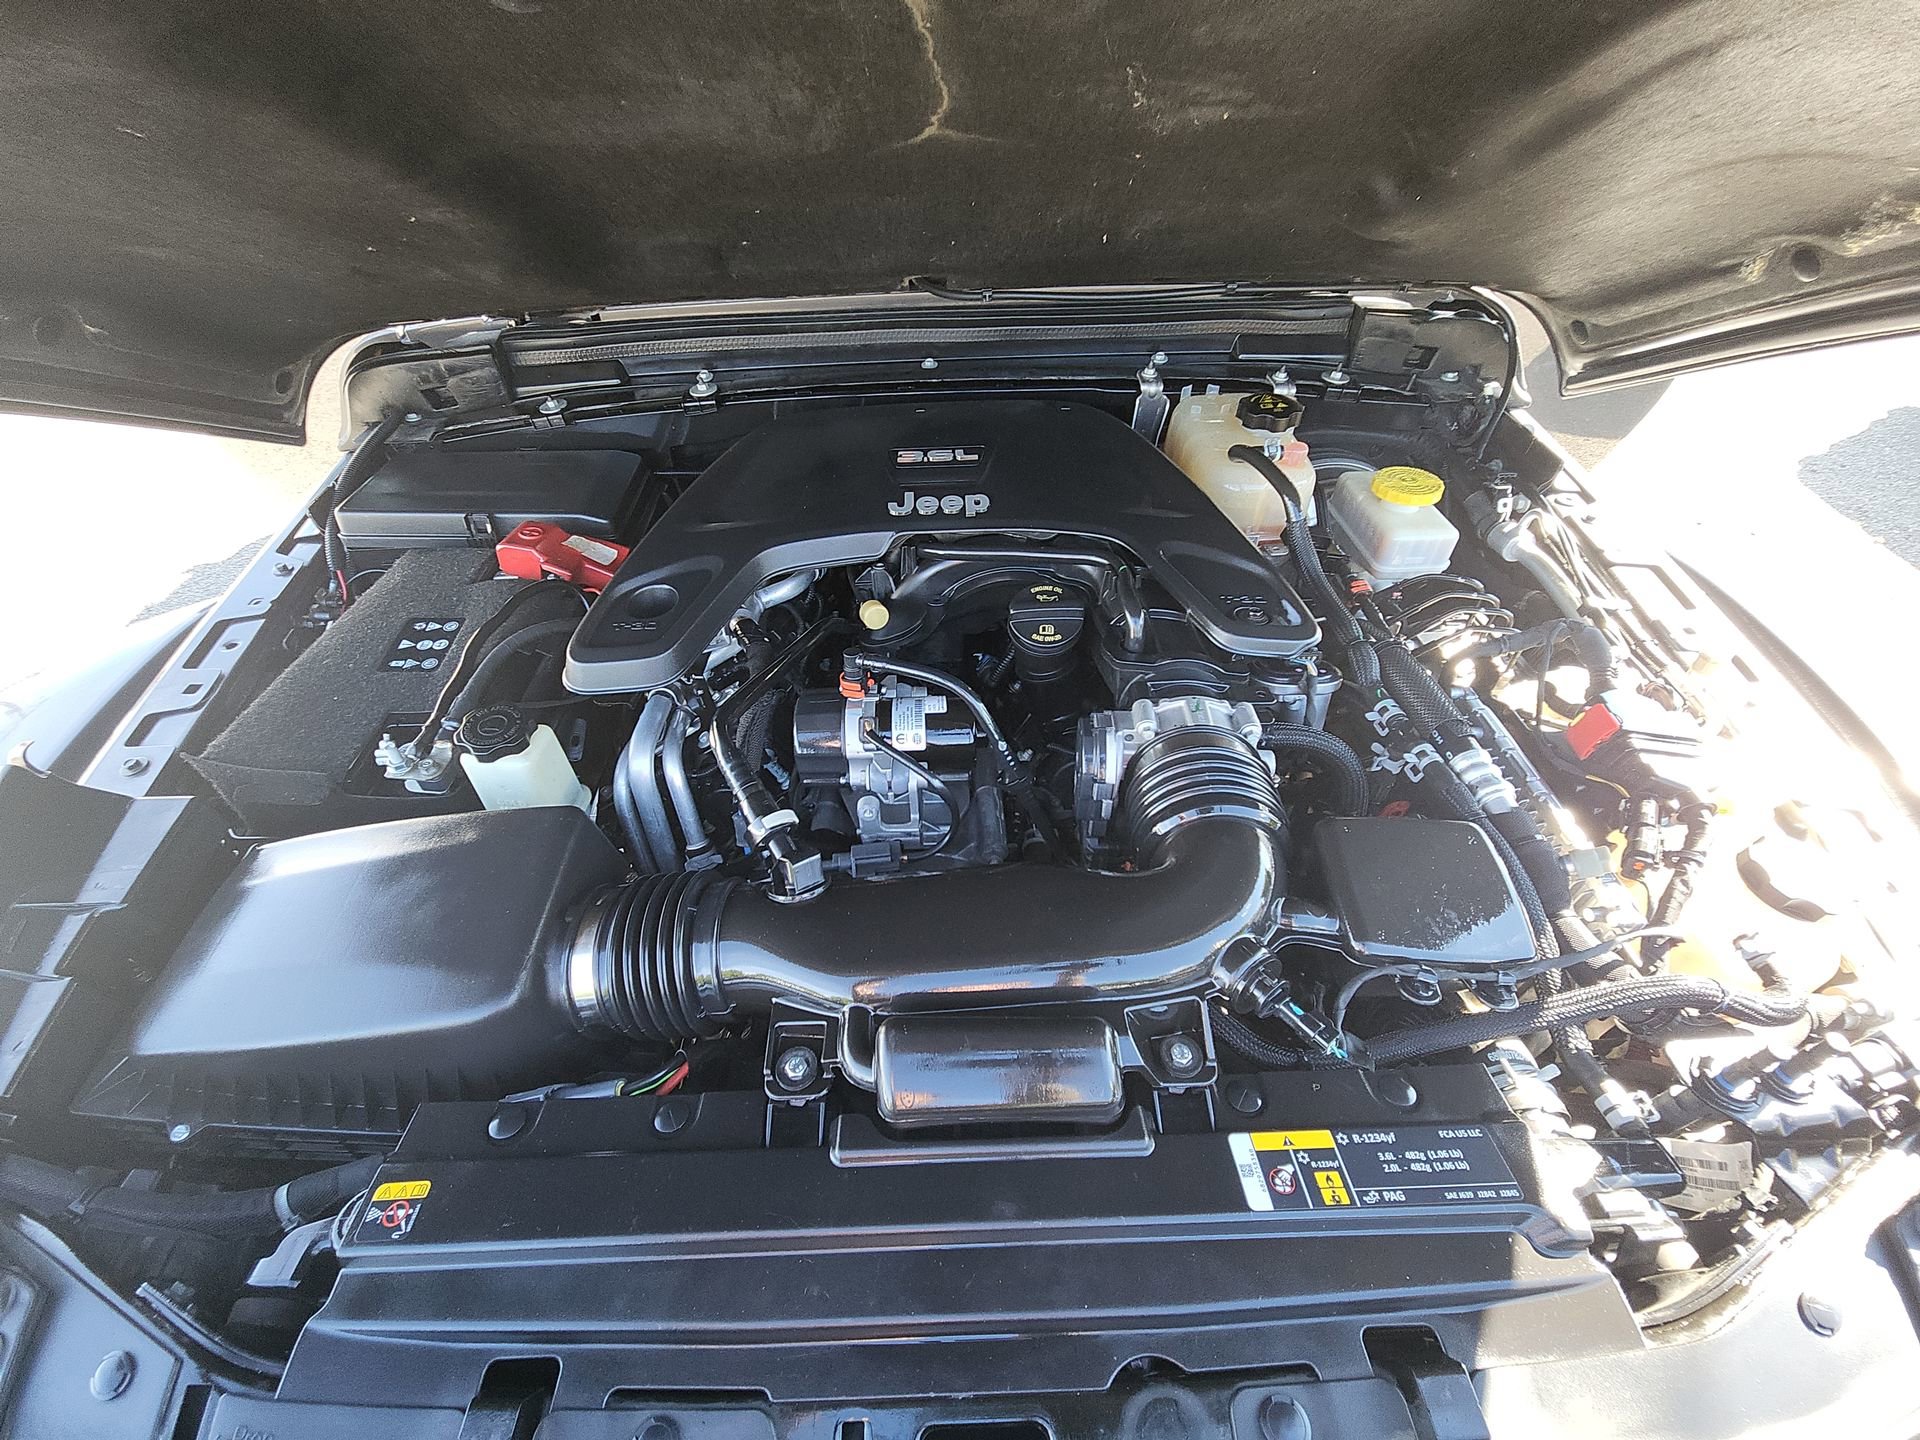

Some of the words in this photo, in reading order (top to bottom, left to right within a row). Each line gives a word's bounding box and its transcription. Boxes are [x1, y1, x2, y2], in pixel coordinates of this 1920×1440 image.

[897, 449, 979, 463] 3.6L
[888, 491, 990, 517] Jeep
[1030, 585, 1053, 593] ENGINE
[1053, 586, 1063, 594] OIL
[1351, 1132, 1396, 1144] R-1234yf
[1437, 1130, 1455, 1138] FCA
[1455, 1129, 1467, 1138] US
[1467, 1128, 1483, 1137] LLC
[1377, 1152, 1397, 1161] 3.6L
[1405, 1150, 1426, 1161] 482g
[1427, 1150, 1449, 1160] (1.06
[1382, 1163, 1402, 1173] 2.0L
[1410, 1162, 1432, 1173] 482g
[1433, 1161, 1455, 1172] (1.06
[1382, 1190, 1406, 1202] PAG
